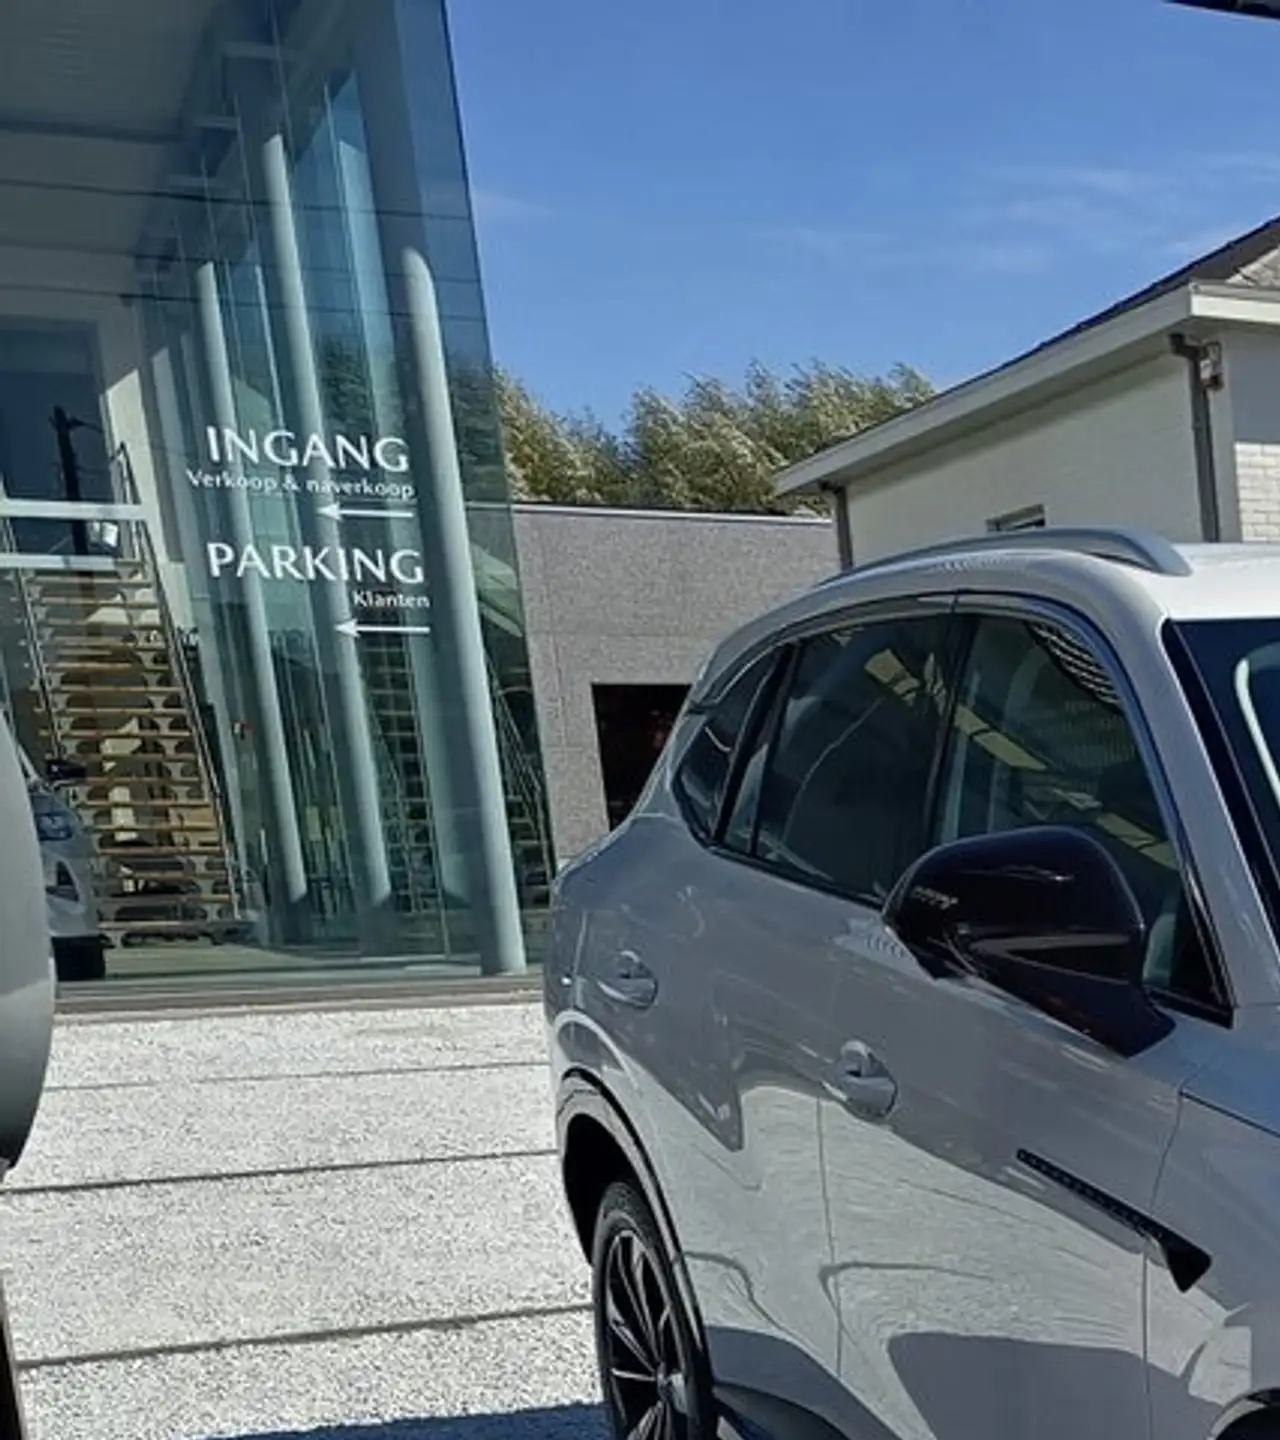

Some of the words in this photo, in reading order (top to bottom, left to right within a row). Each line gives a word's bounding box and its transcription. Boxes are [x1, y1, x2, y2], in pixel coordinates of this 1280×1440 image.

[206, 425, 410, 473] INGANG
[186, 468, 277, 496] Verkoop
[282, 473, 300, 492] &
[306, 477, 415, 500] naverkoop
[206, 542, 425, 584] PARKING
[352, 590, 431, 609] Klanten
